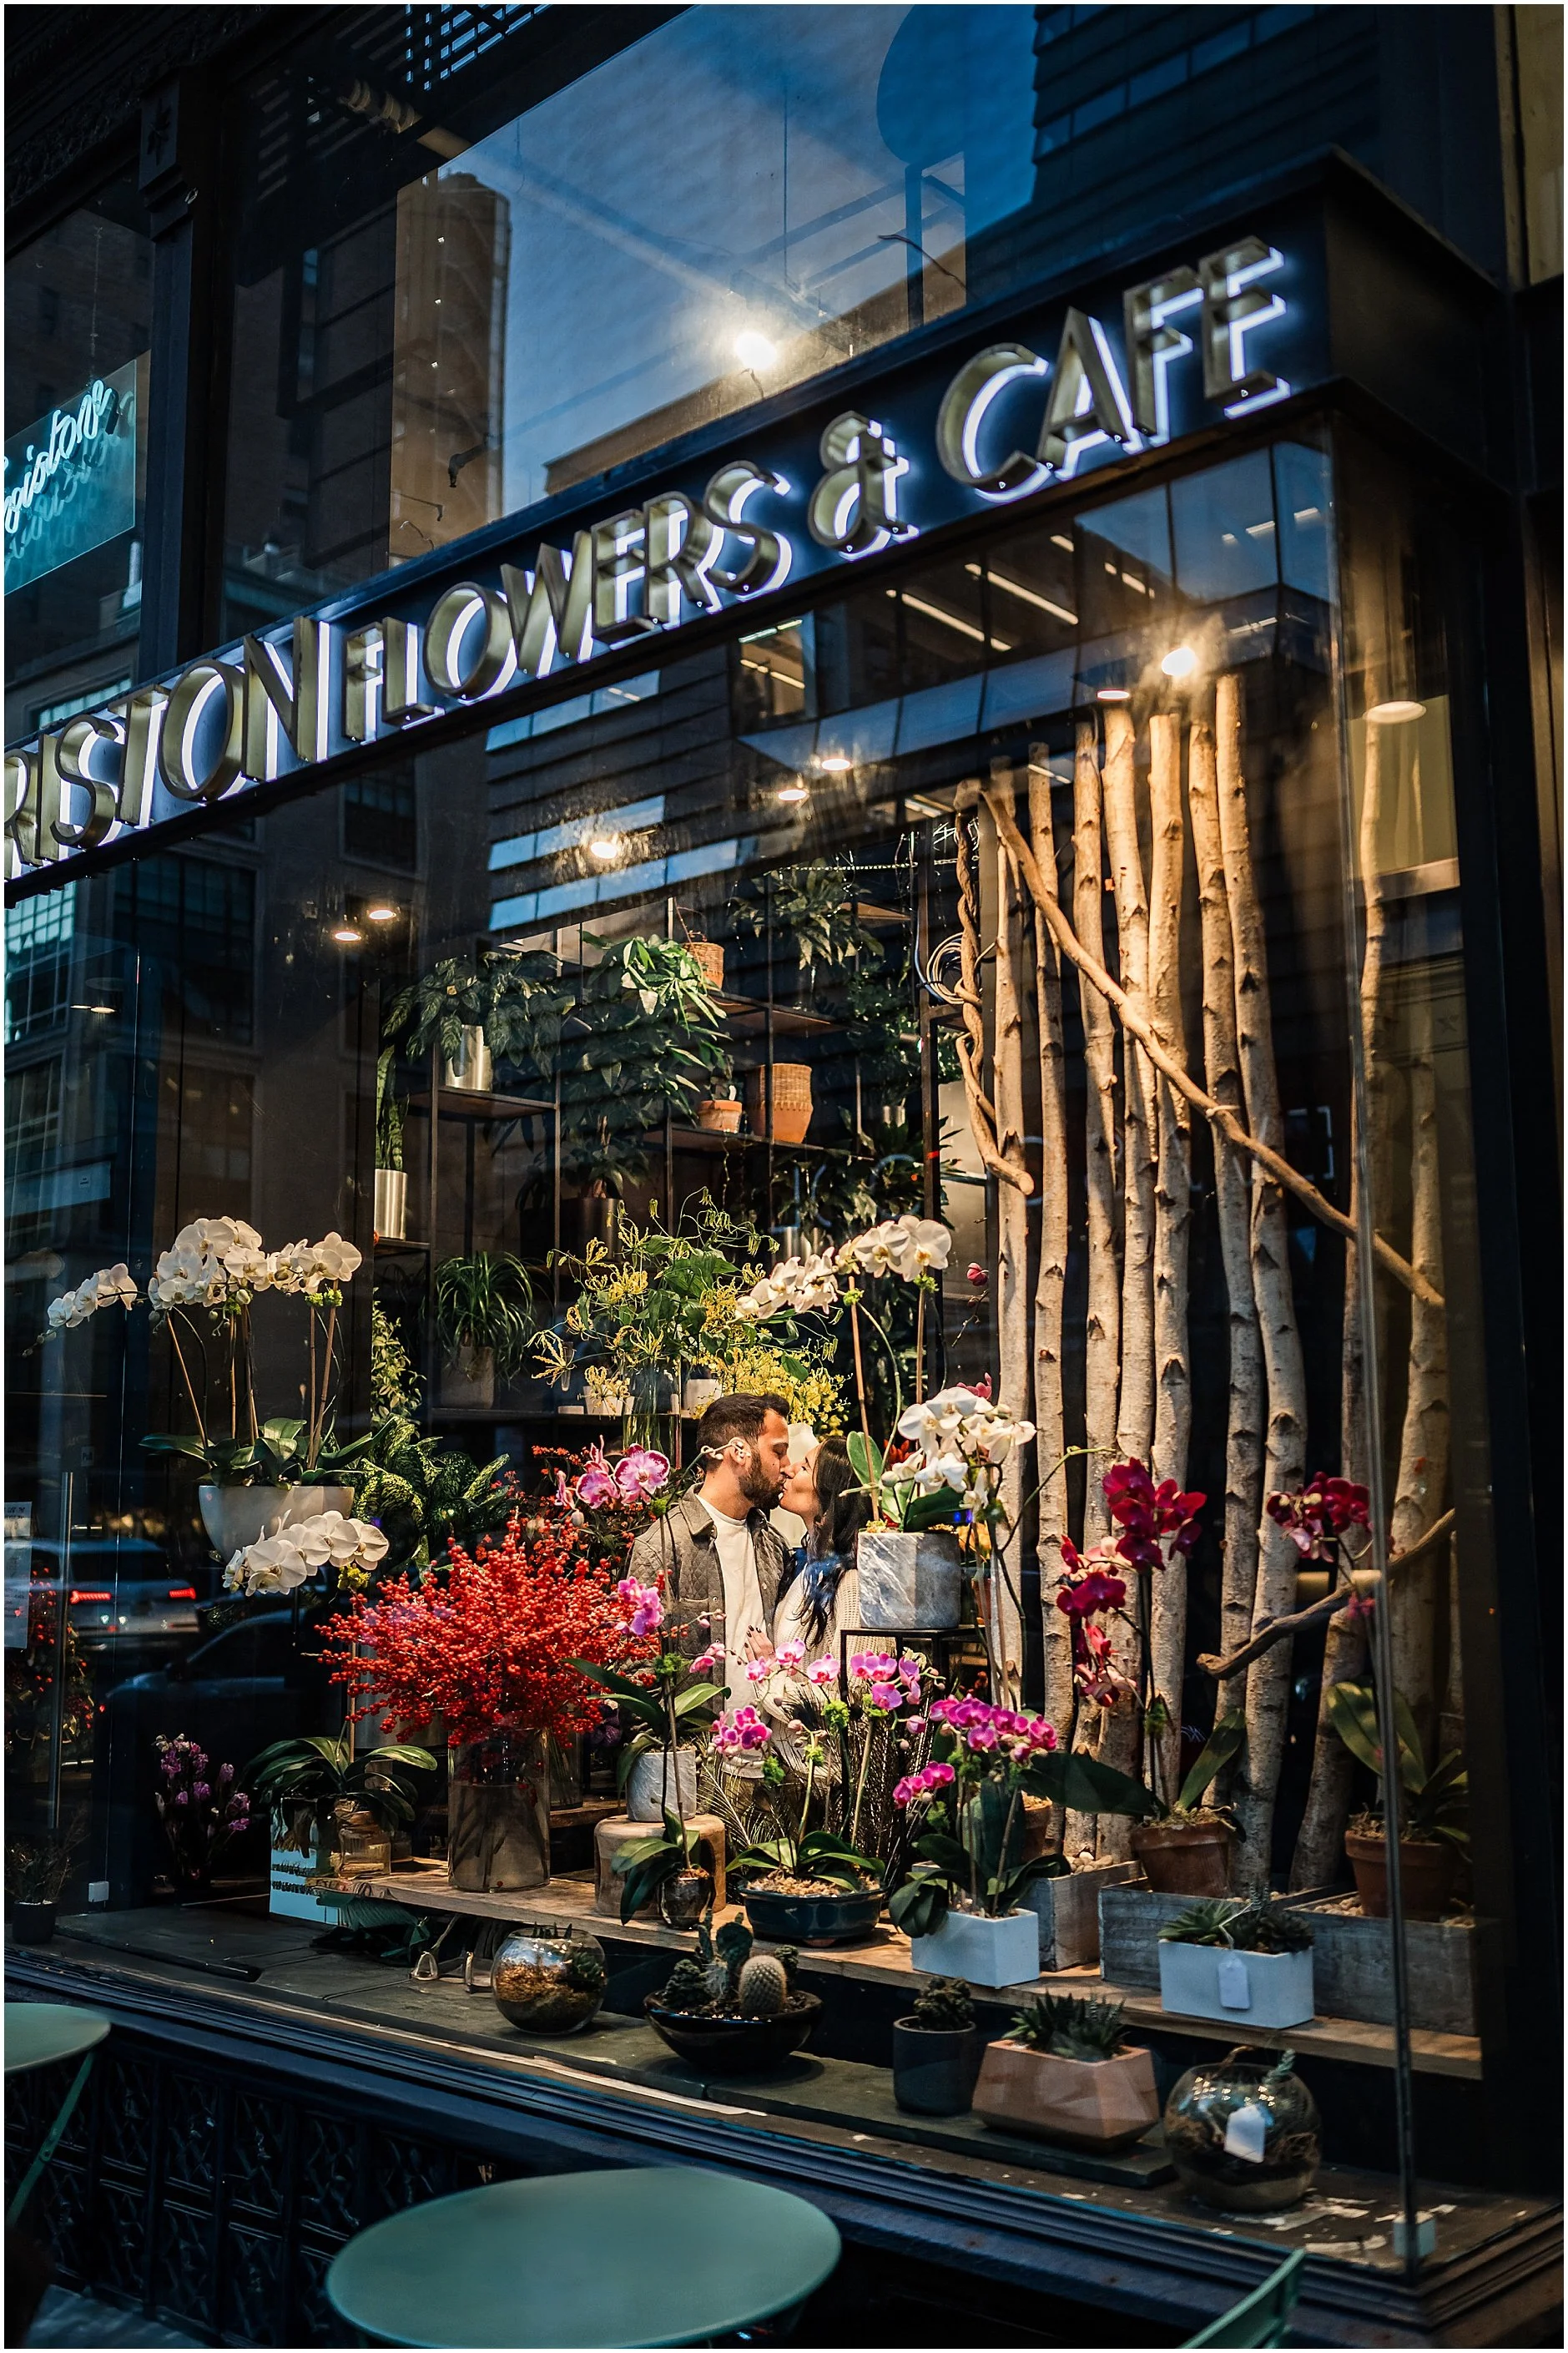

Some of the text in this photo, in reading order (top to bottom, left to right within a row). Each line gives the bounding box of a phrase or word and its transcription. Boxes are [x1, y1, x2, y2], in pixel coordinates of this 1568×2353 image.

[341, 460, 792, 745] FLOWERS
[808, 410, 920, 561] &
[935, 235, 1291, 502] CAFE
